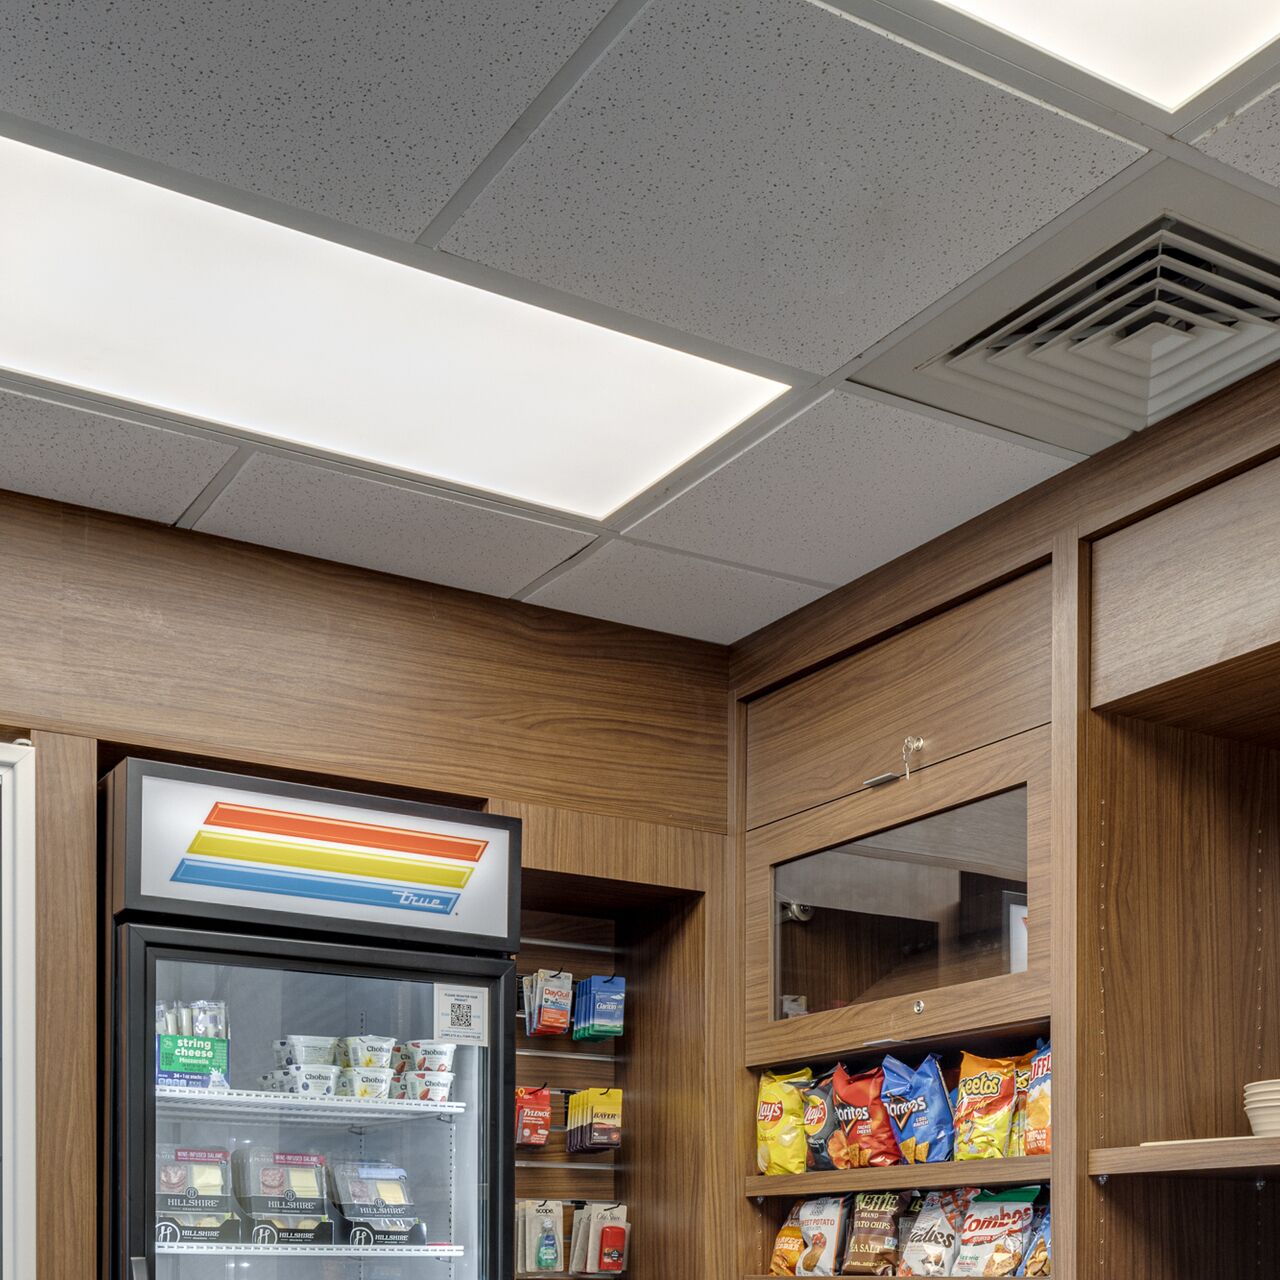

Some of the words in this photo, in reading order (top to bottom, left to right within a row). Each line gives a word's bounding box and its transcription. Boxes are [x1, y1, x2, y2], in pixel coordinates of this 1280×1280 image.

[544, 987, 570, 998] DayQuil
[177, 1038, 211, 1050] string
[175, 1047, 213, 1058] cheese
[523, 1108, 550, 1118] TYLENOL
[167, 1198, 219, 1208] HILLSHIRE
[268, 1200, 316, 1209] HILLSHIRE
[360, 1206, 406, 1215] HILLSHIRE
[871, 1221, 891, 1229] CHIPS
